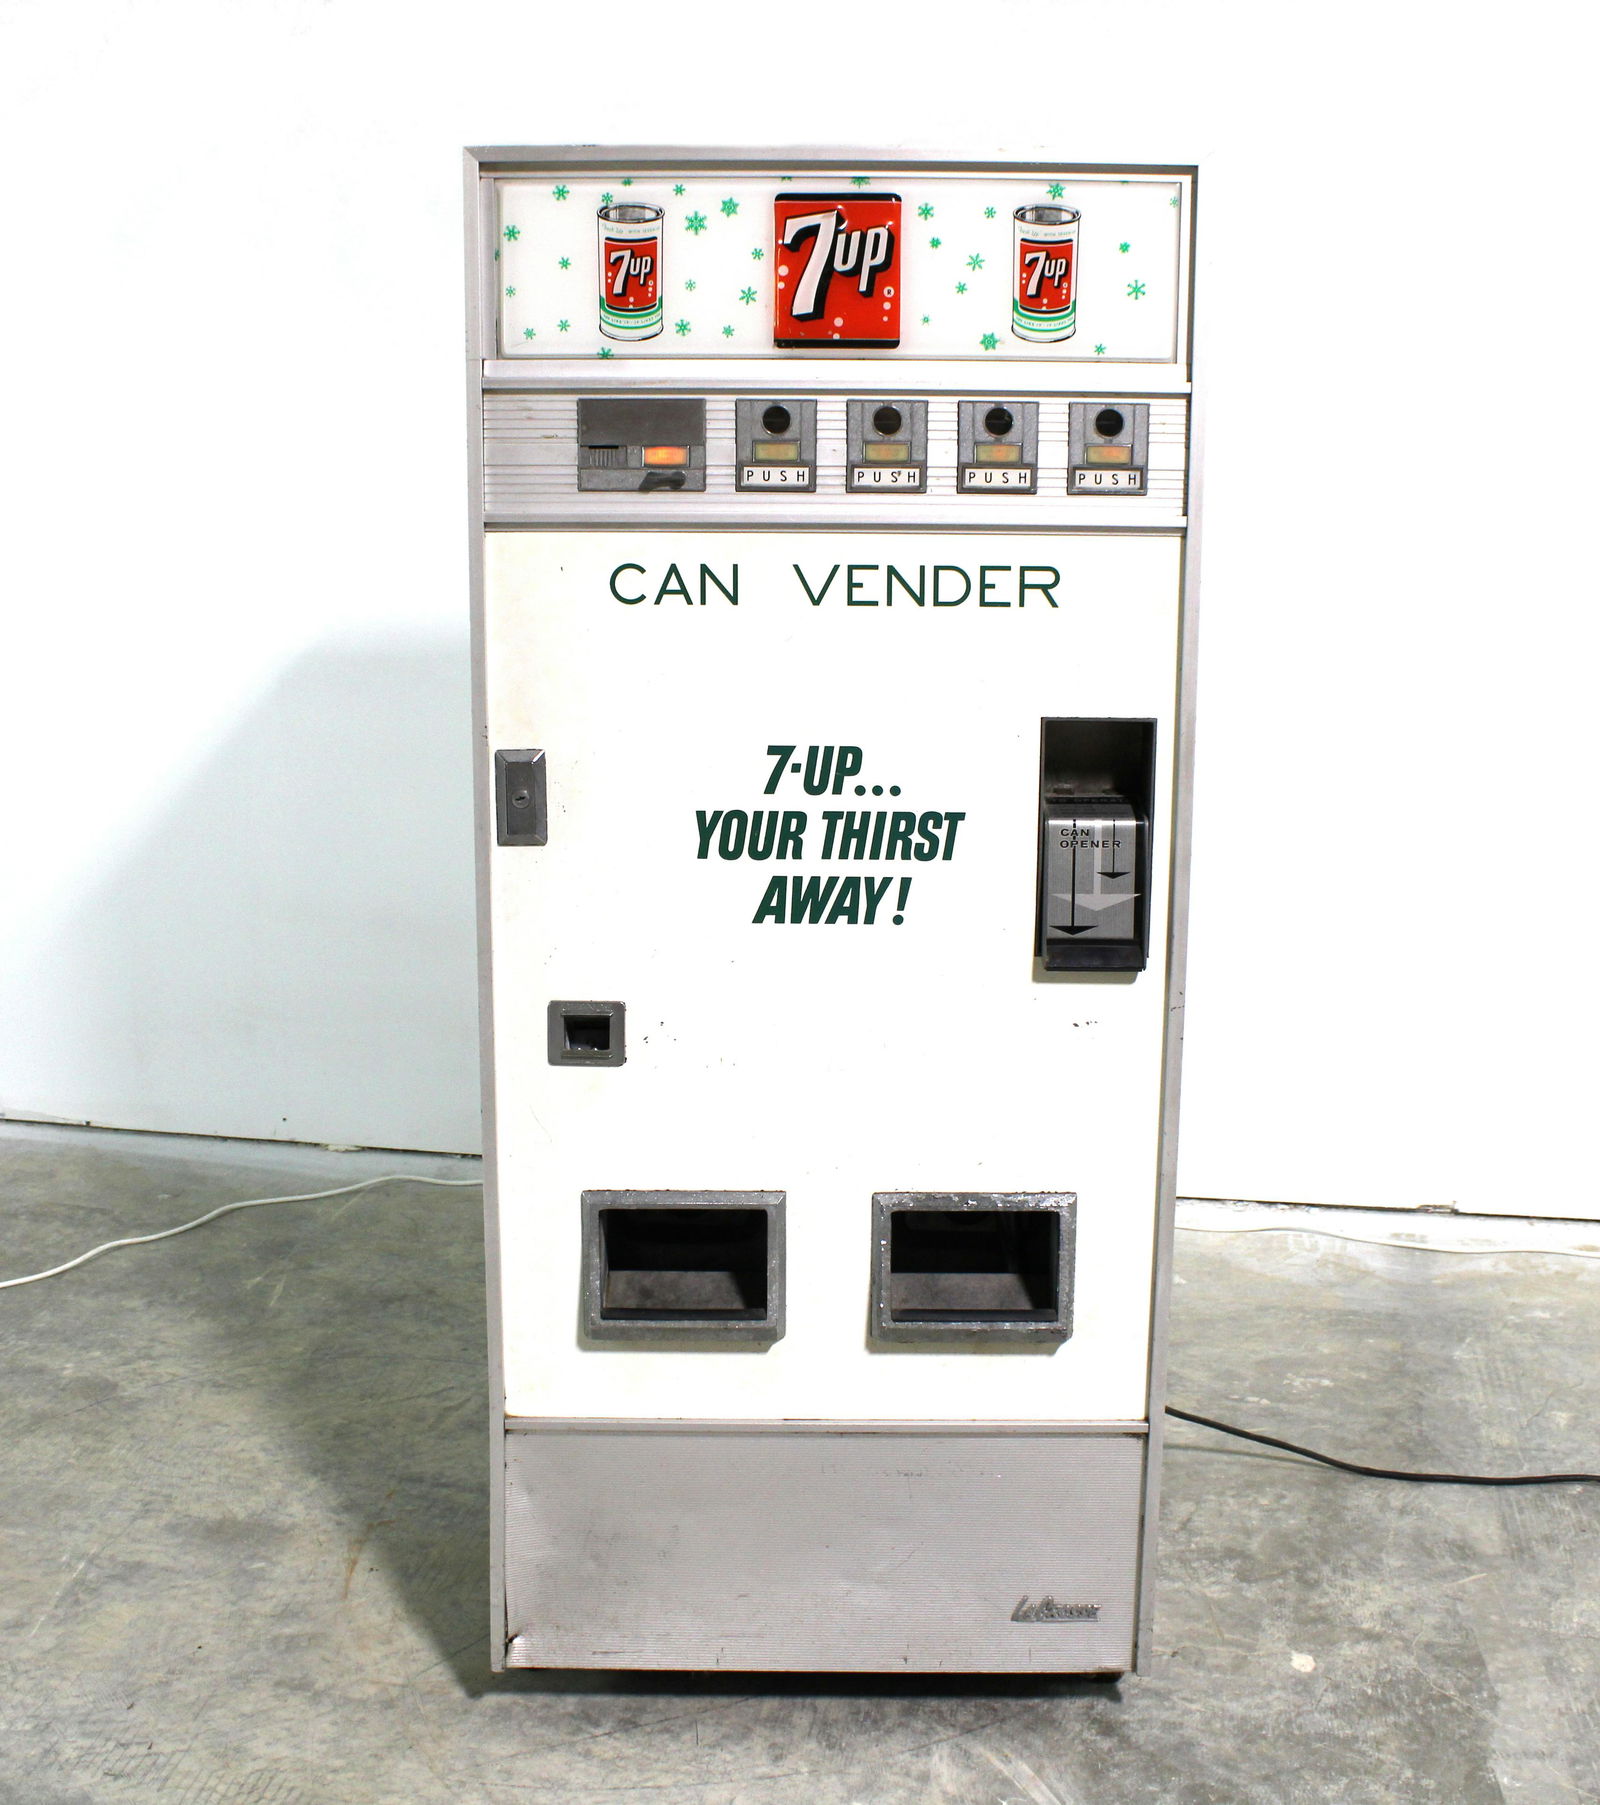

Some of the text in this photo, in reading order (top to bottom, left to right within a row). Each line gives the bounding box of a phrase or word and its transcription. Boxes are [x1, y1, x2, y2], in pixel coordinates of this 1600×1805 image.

[609, 249, 654, 297] 7up
[783, 208, 893, 320] 7up
[1024, 250, 1069, 298] 7up
[746, 470, 805, 482] PUSH
[857, 471, 916, 483] PUSH
[968, 472, 1027, 484] PUSH
[1078, 473, 1137, 485] PUSH
[609, 562, 1061, 609] CAN VENDER
[695, 809, 967, 862] YOUR THIRST
[1059, 840, 1122, 849] OPENER
[1060, 828, 1090, 837] CAN
[751, 875, 913, 926] AWAY!
